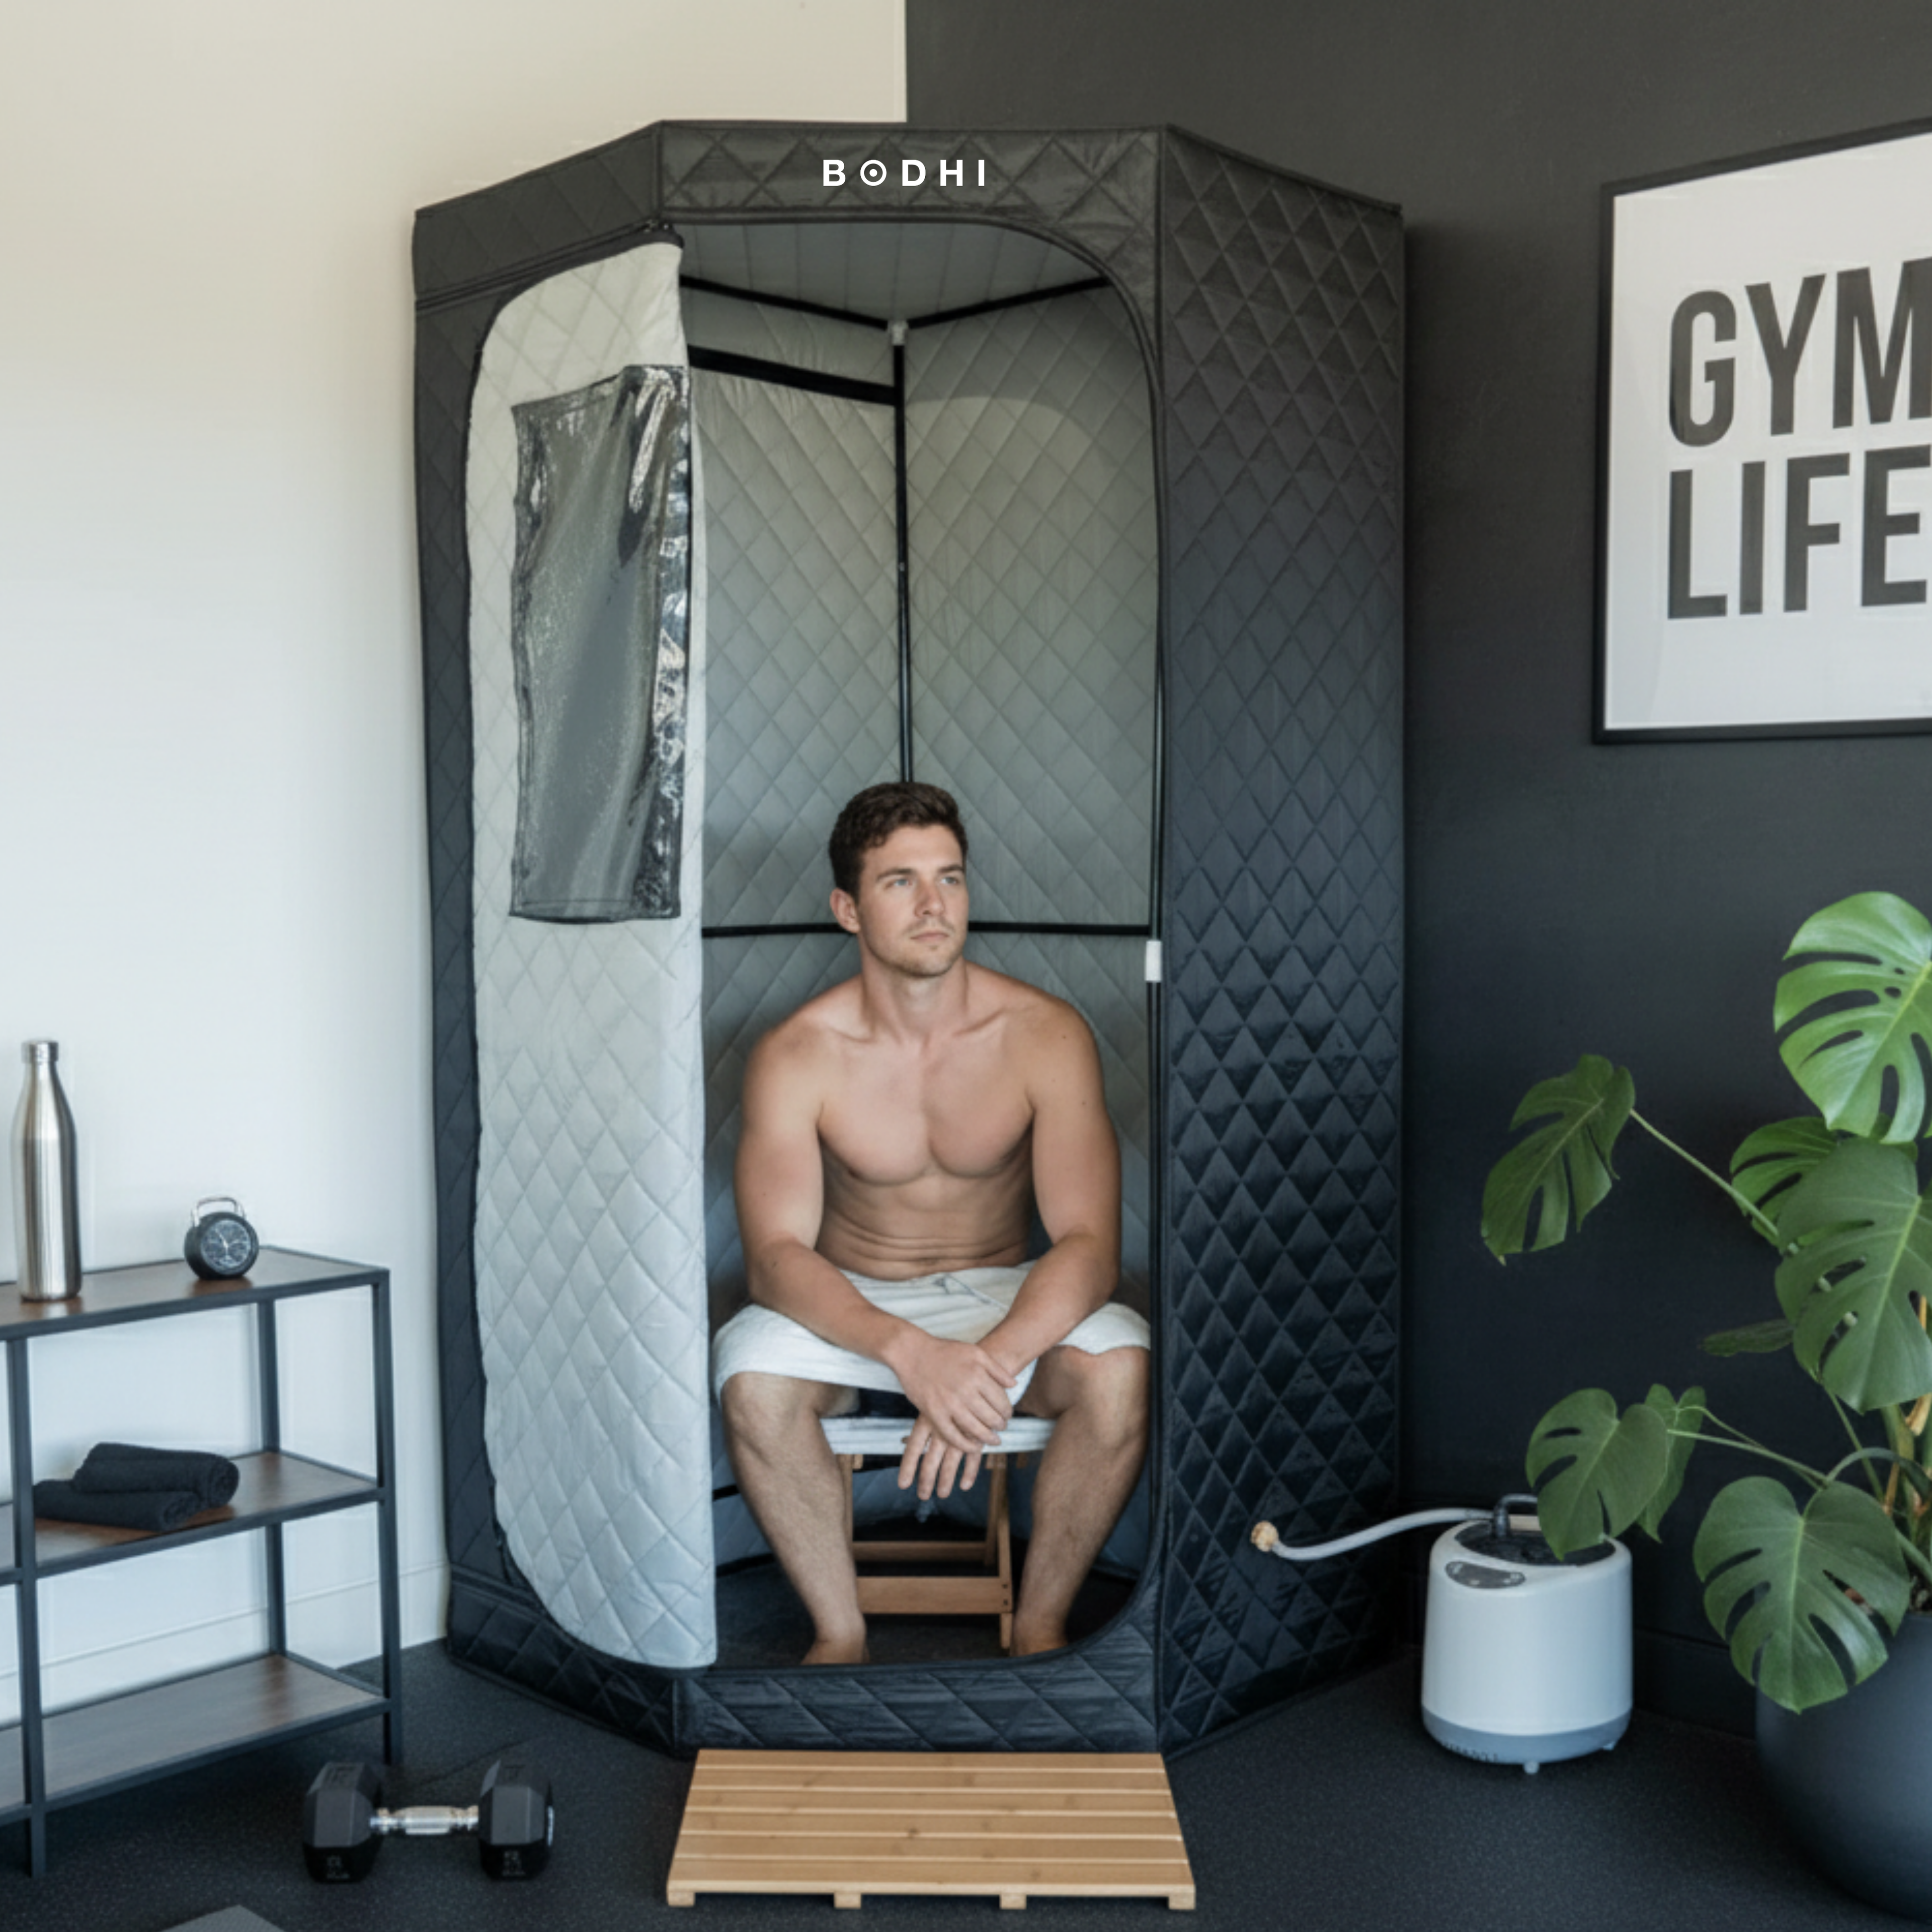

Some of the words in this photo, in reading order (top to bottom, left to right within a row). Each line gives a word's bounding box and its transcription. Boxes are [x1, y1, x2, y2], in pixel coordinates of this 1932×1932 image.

[823, 159, 985, 187] BODHI
[1669, 257, 1932, 447] GYM
[1668, 445, 1931, 619] LIFE
